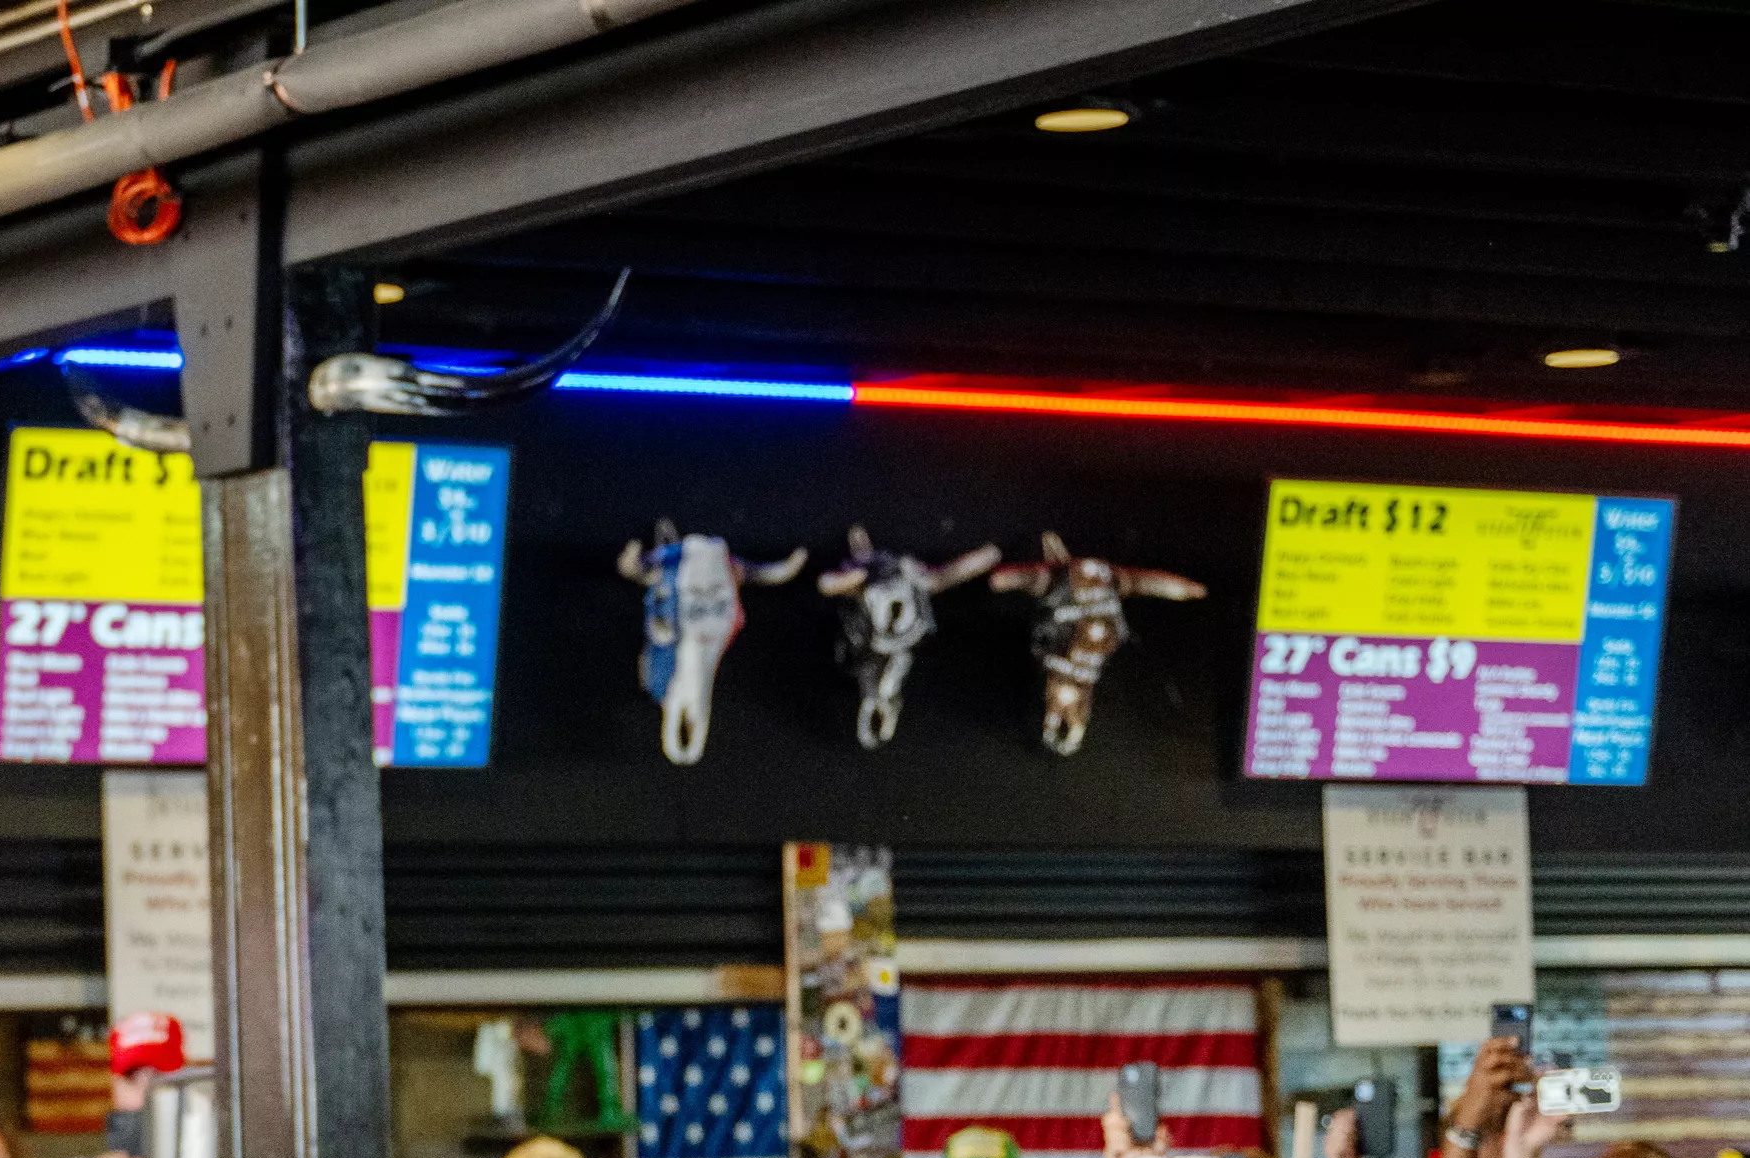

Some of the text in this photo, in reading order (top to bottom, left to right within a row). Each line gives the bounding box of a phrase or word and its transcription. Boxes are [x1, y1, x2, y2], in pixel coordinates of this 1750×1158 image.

[23, 445, 132, 485] Draft
[1279, 495, 1371, 534] Draft
[1383, 498, 1449, 535] $12
[90, 603, 206, 650] Cans
[1328, 635, 1423, 679] Cans
[1425, 635, 1478, 684] $9
